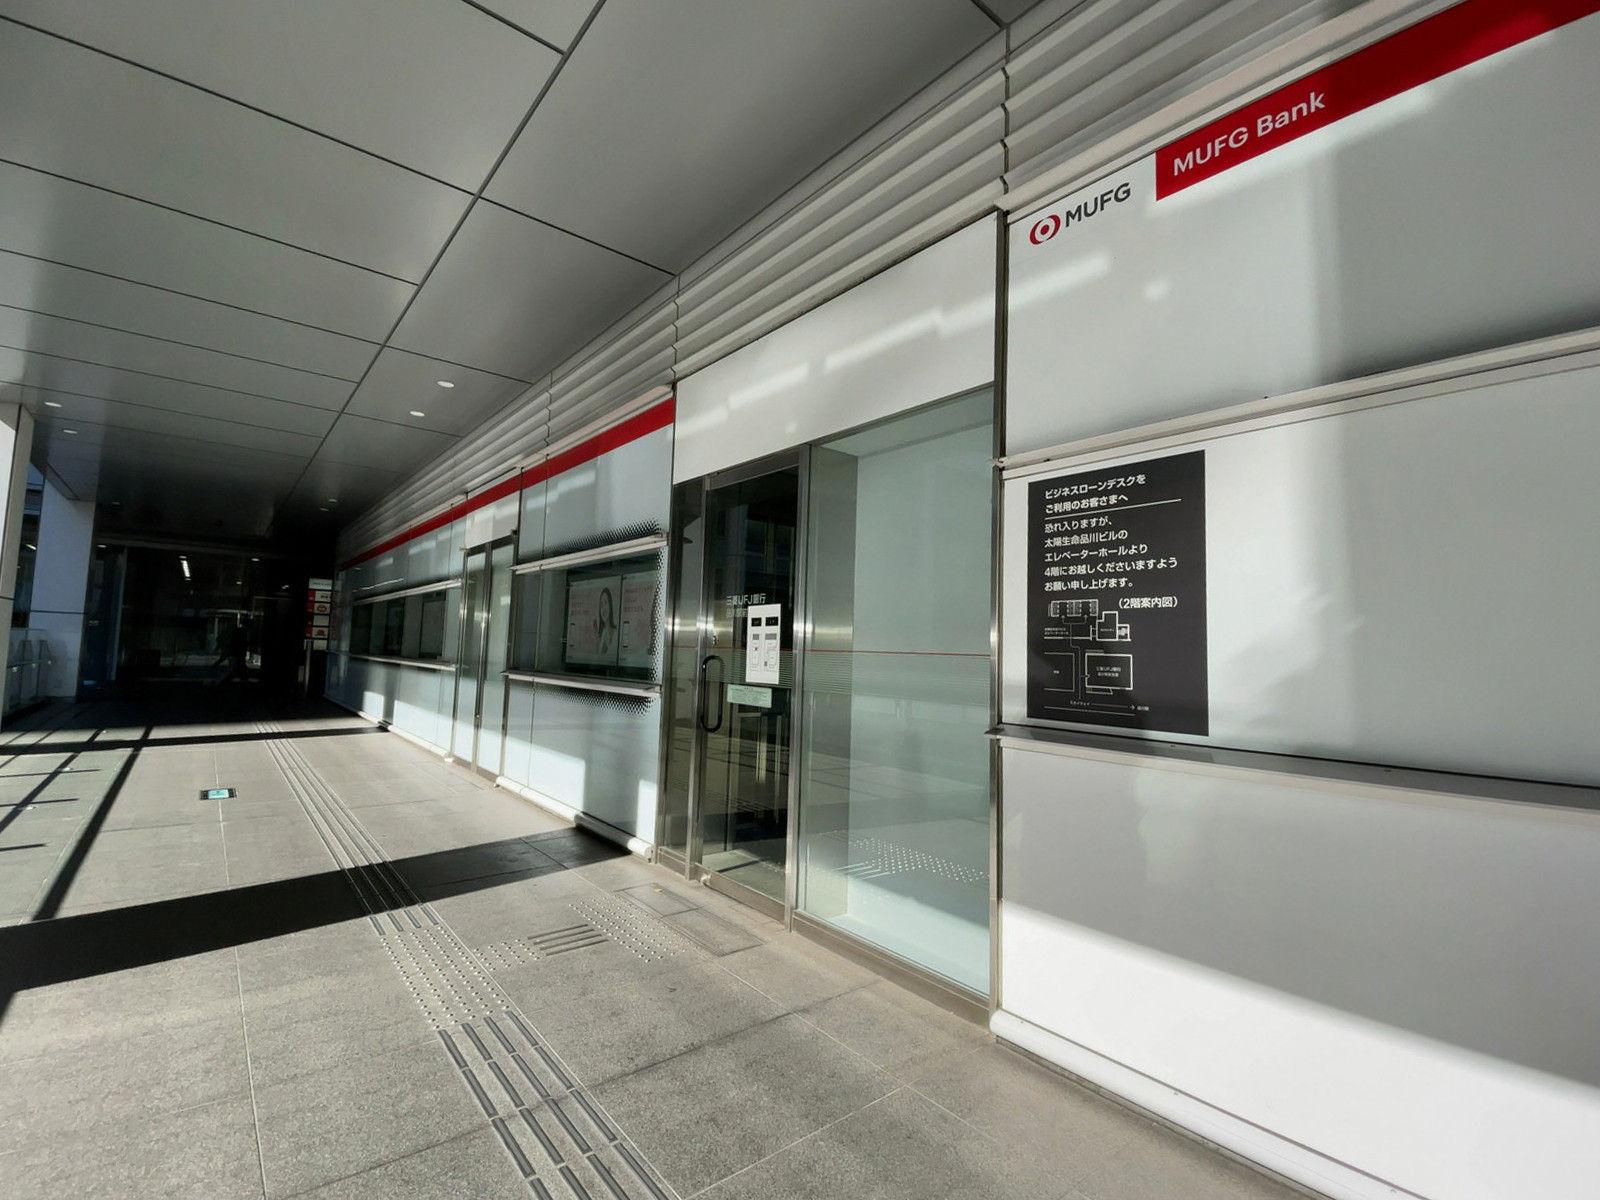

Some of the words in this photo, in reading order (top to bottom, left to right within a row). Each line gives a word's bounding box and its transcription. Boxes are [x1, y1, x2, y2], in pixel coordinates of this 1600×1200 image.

[1173, 127, 1248, 176] MUFG
[1257, 91, 1326, 138] Bank
[1065, 182, 1131, 228] MUFG
[1045, 474, 1147, 499] ビジネスローンデスクを
[1045, 494, 1129, 514] ご利用のお客さまへ
[1044, 517, 1112, 533] 恐れ入りますが、
[1044, 530, 1128, 548] 太陽生命品川ビルの
[1044, 544, 1148, 562] エレベーターホールより
[1044, 557, 1178, 577] 4階にお越しくださいますよう
[1044, 578, 1133, 591] お願い申し上げます。
